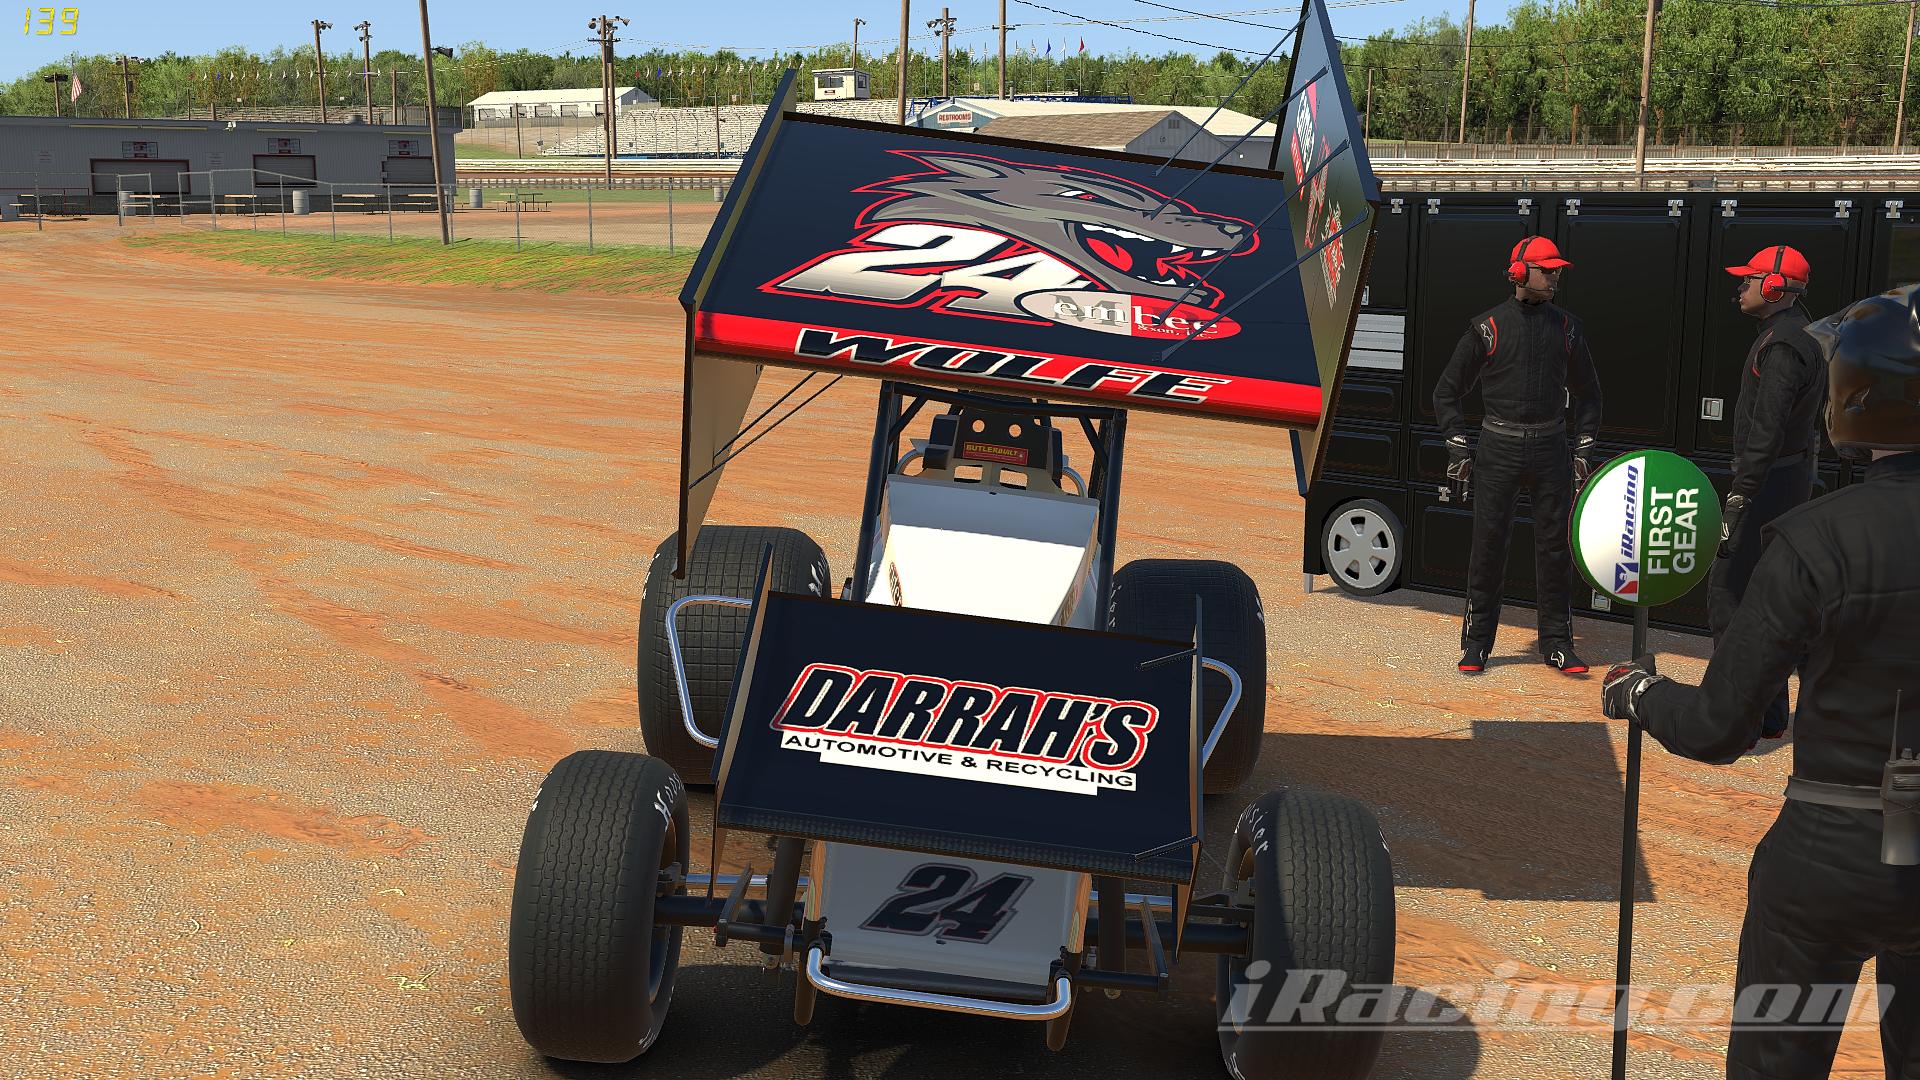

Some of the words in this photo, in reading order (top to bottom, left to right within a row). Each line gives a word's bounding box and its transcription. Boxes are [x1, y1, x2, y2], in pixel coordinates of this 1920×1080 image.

[938, 113, 972, 122] RESTROOMS
[763, 222, 1098, 321] 24
[795, 328, 1231, 403] WOLFE
[1620, 464, 1638, 560] iRacing
[1648, 486, 1673, 574] FIRST
[1672, 488, 1699, 574] GEAR
[773, 664, 1158, 770] DARRAH'S
[784, 735, 953, 766] AUTOMOTIVE
[960, 756, 978, 769] &
[986, 759, 1133, 788] RECYCLING
[860, 863, 1033, 944] 24
